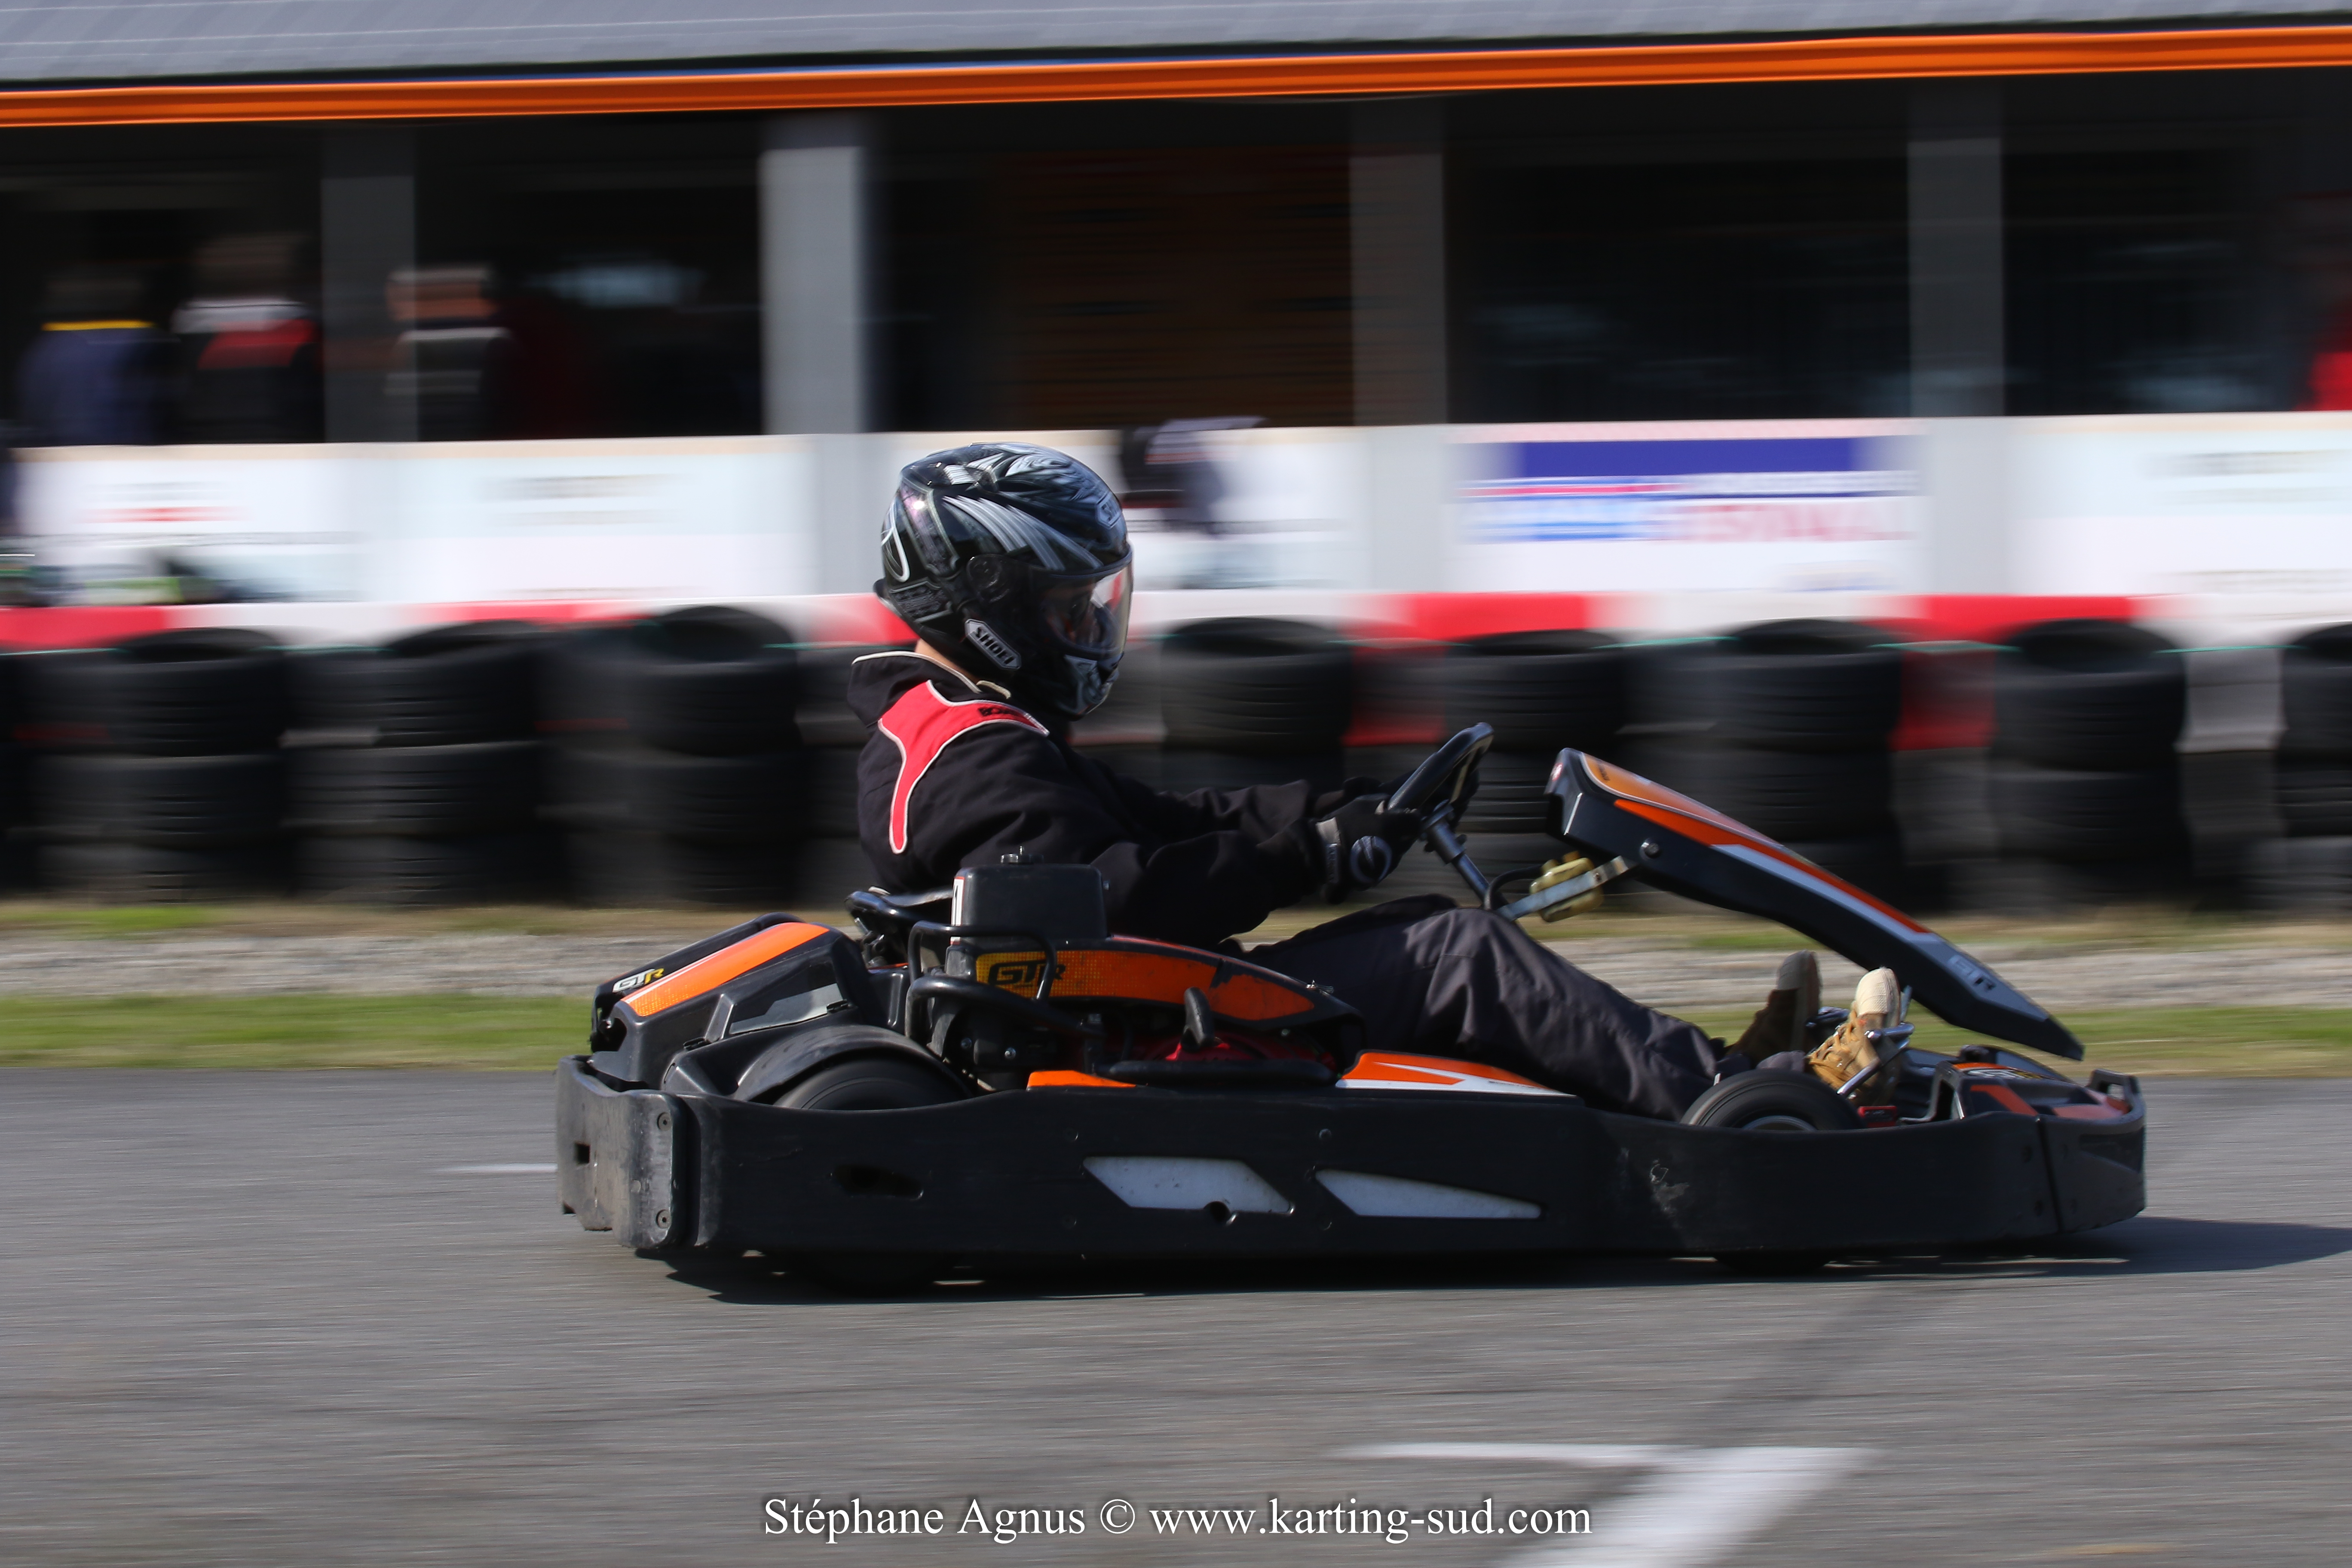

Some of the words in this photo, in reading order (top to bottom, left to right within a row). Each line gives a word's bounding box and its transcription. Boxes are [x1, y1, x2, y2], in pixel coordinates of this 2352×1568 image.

[972, 625, 1015, 665] SHOEI
[612, 968, 665, 993] GTR
[988, 959, 1066, 985] GTR
